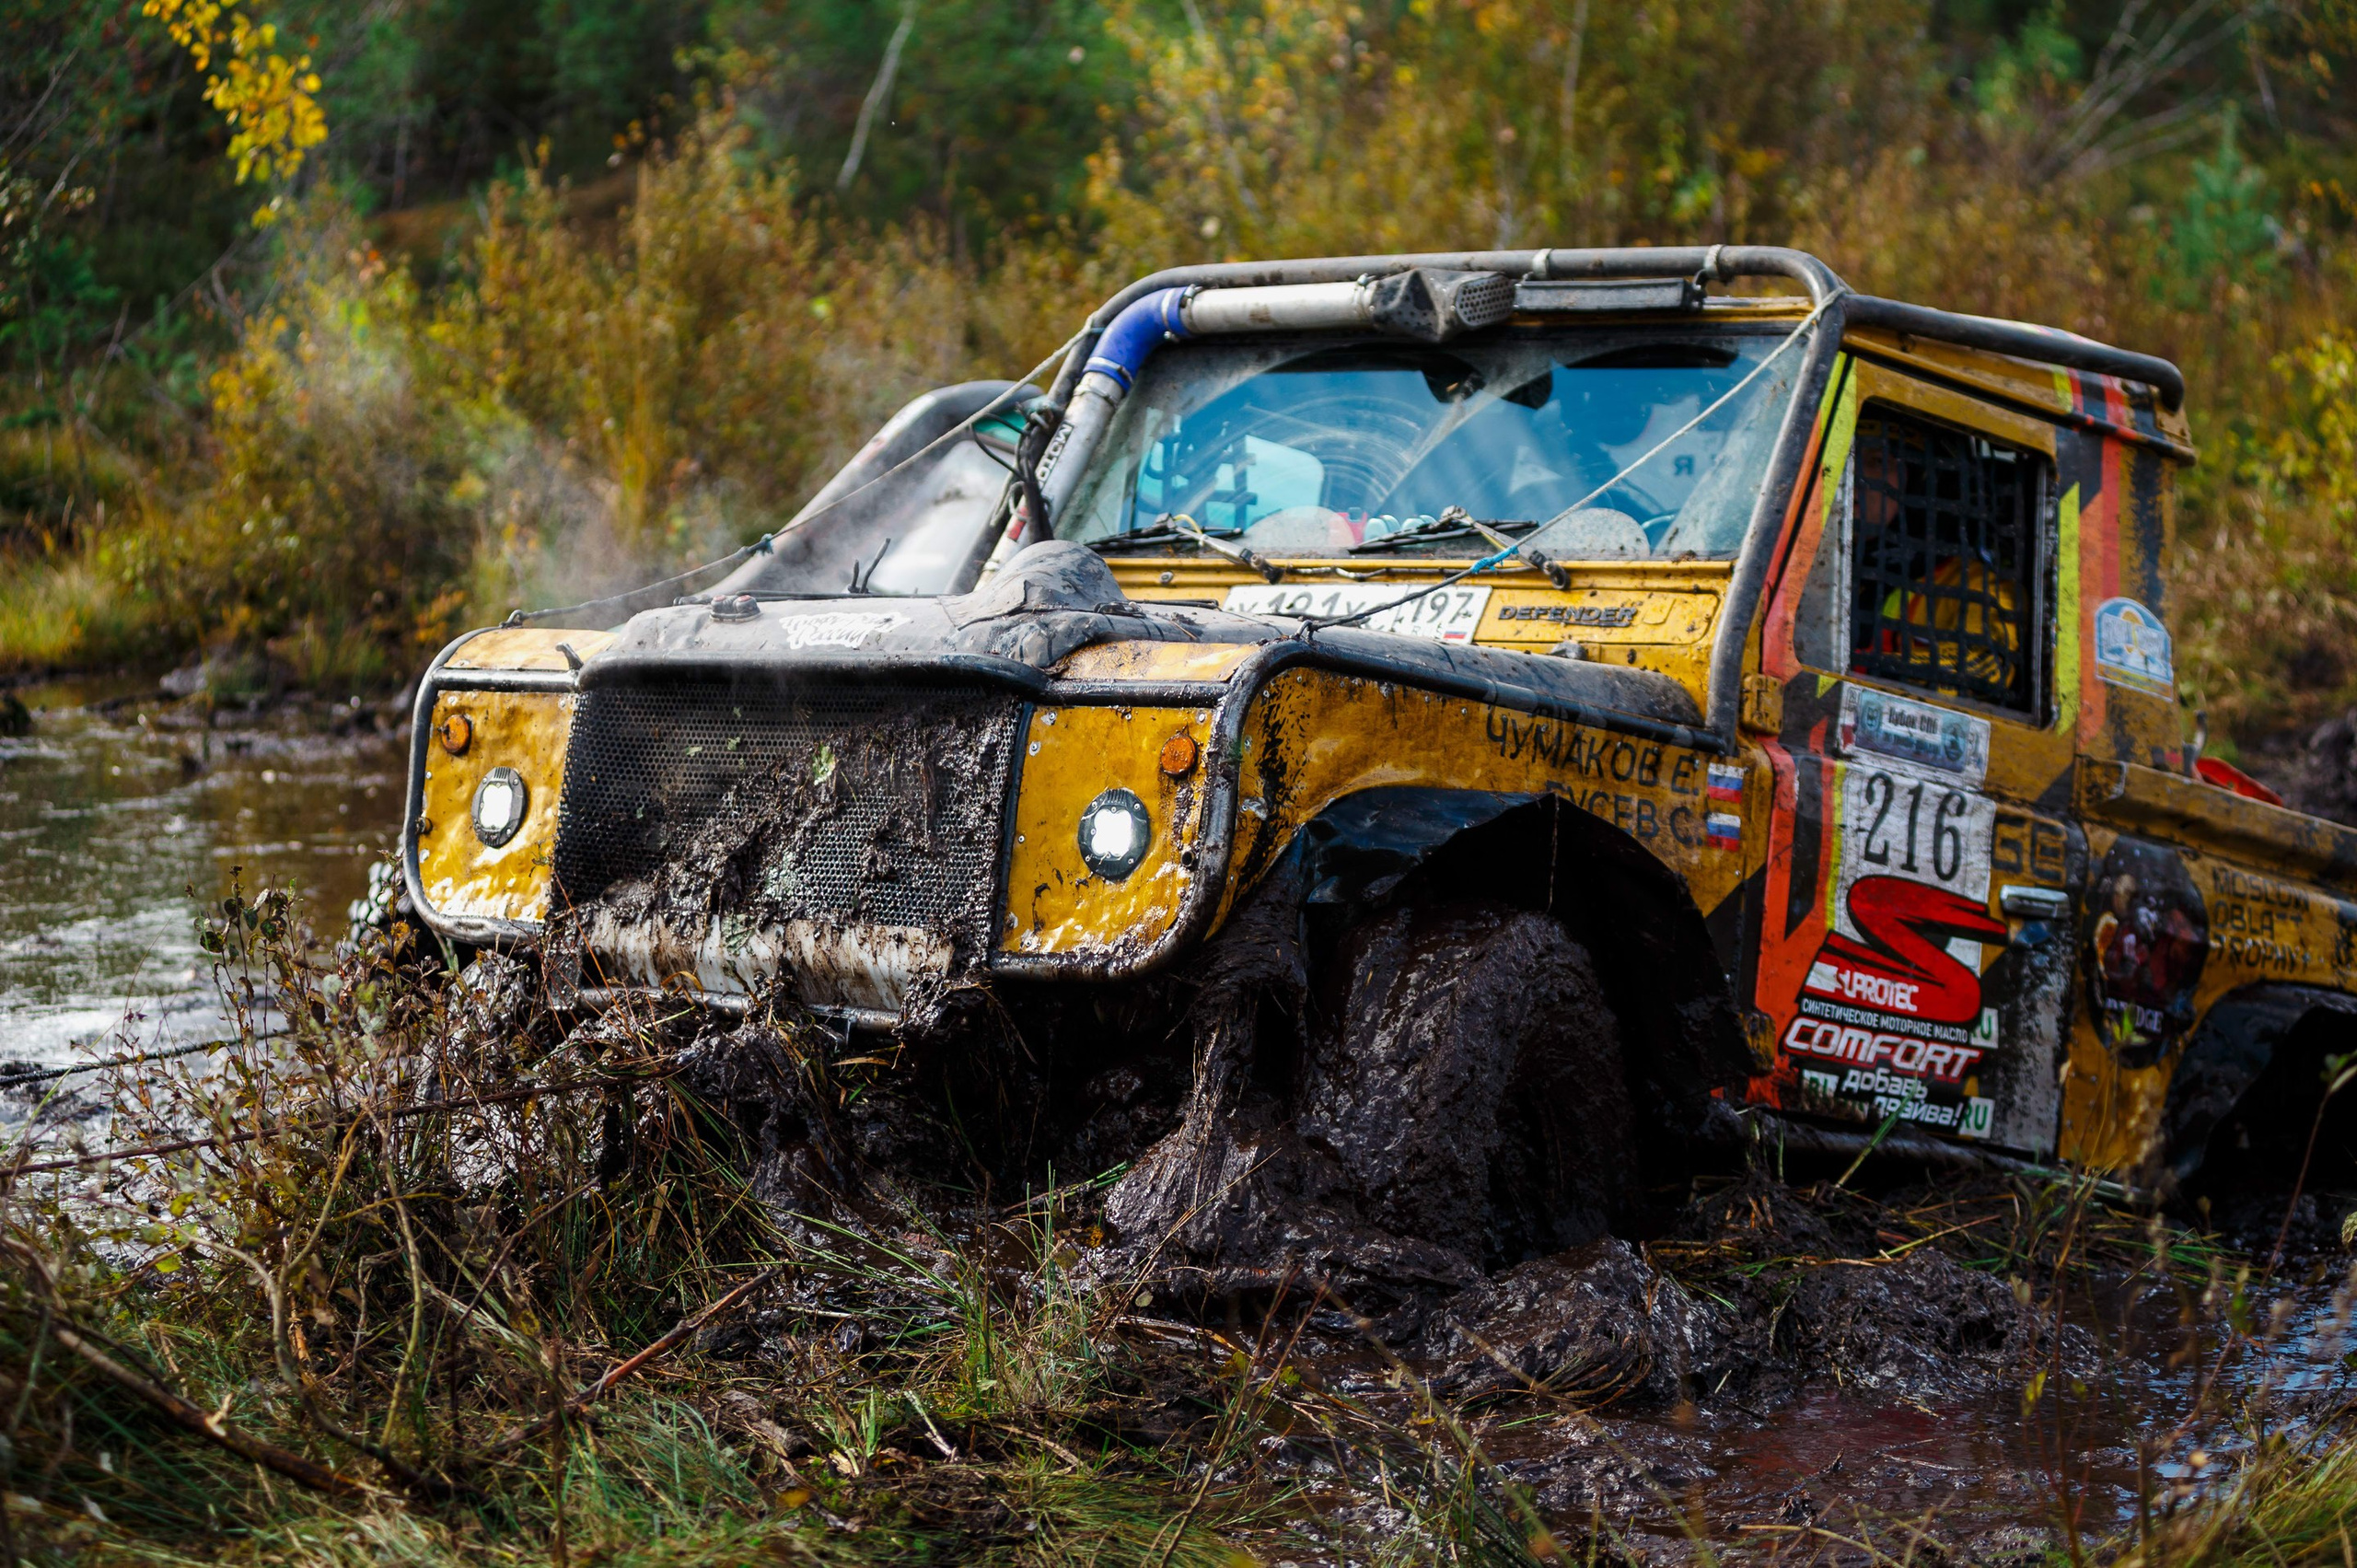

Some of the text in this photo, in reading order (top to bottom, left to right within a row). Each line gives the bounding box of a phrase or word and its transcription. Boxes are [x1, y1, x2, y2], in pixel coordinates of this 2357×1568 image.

[1036, 423, 1074, 490] MOTO
[1411, 591, 1474, 624] 197
[1498, 606, 1639, 623] DEFENDER
[1485, 704, 1659, 787] ЧУМАКОВ
[1864, 772, 1967, 881] 216
[1802, 998, 1968, 1042] СИНТЕТИЧЕСКОЕ МОТОРНОЕ МАСЛО
[1783, 1016, 1981, 1079] COMFORT
[1841, 1067, 1929, 1099] добавь
